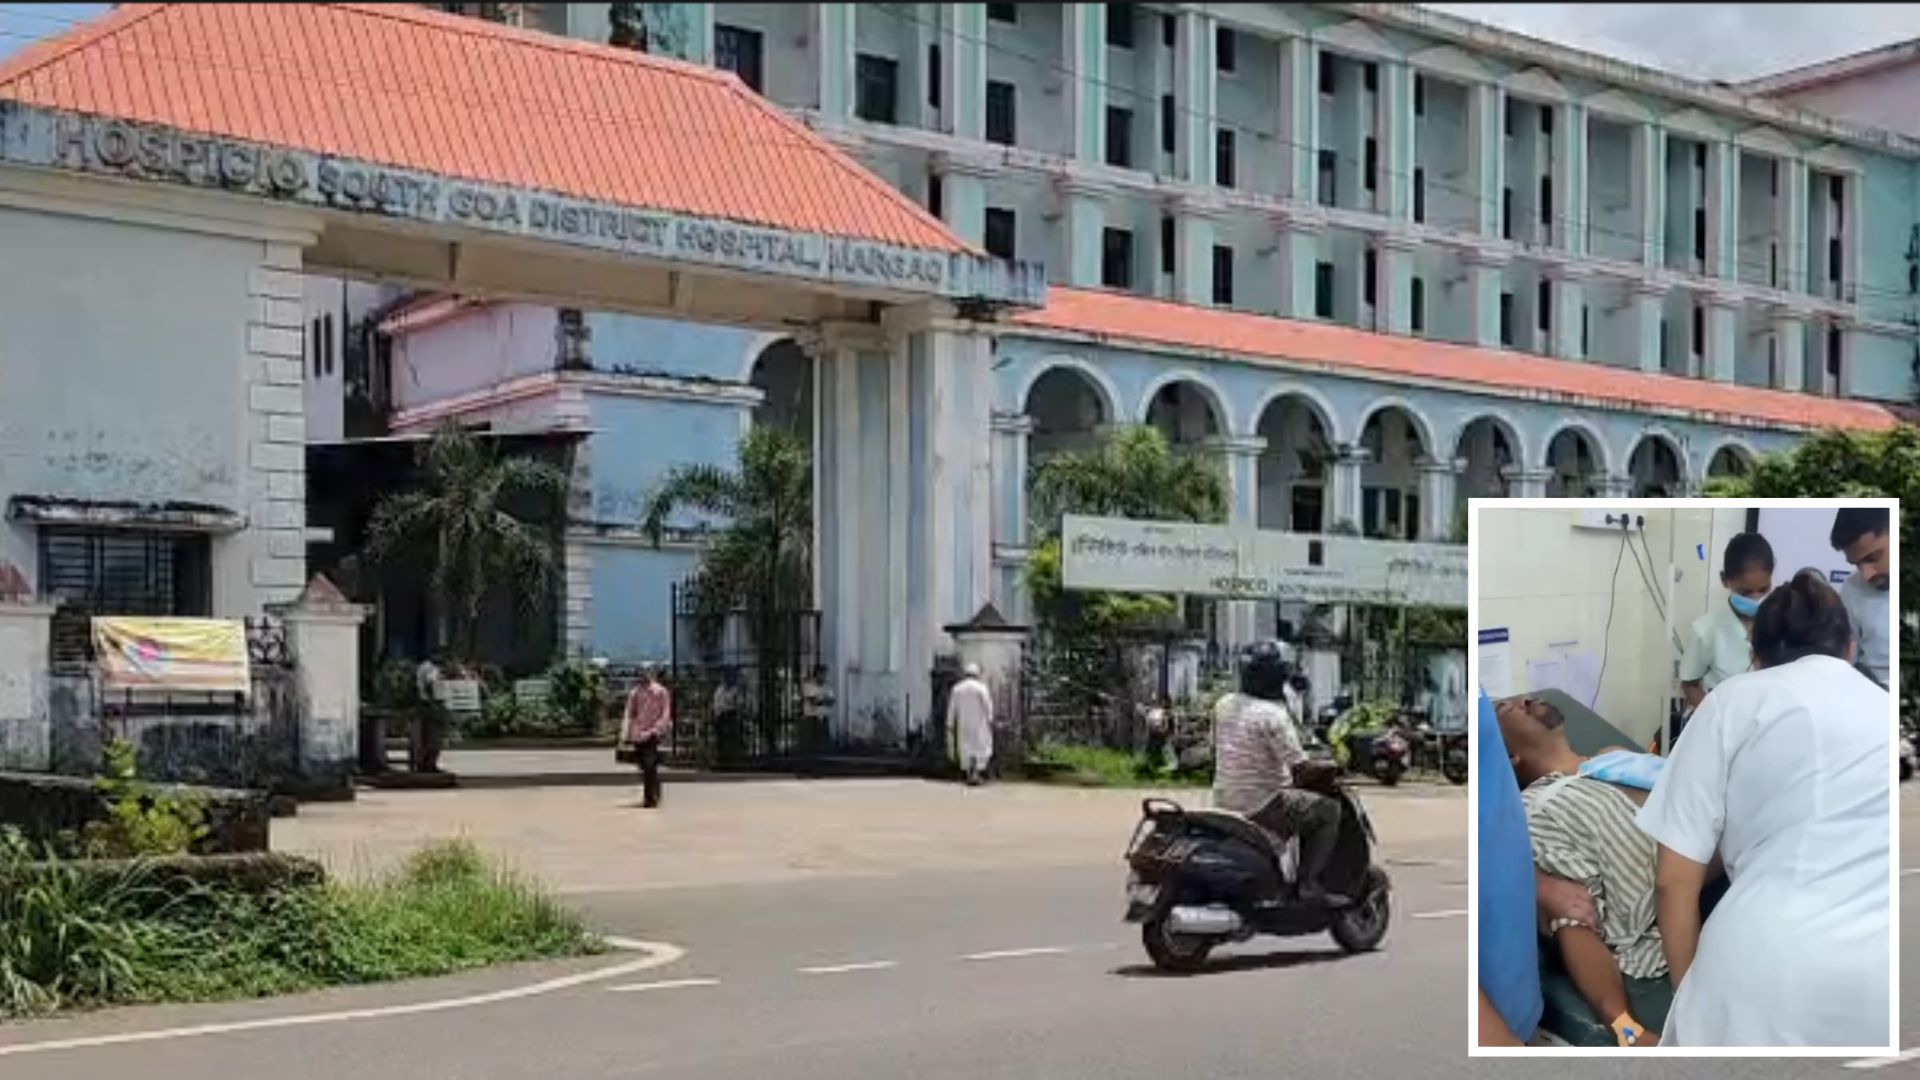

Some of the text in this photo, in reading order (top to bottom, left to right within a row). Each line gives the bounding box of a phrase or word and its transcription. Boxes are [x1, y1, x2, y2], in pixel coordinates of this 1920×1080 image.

[54, 113, 307, 193] HOSPICIO
[318, 160, 439, 213] SOUTH
[450, 186, 521, 224] GOA
[529, 199, 668, 247] DISTRICT
[828, 241, 942, 286] MARGAO
